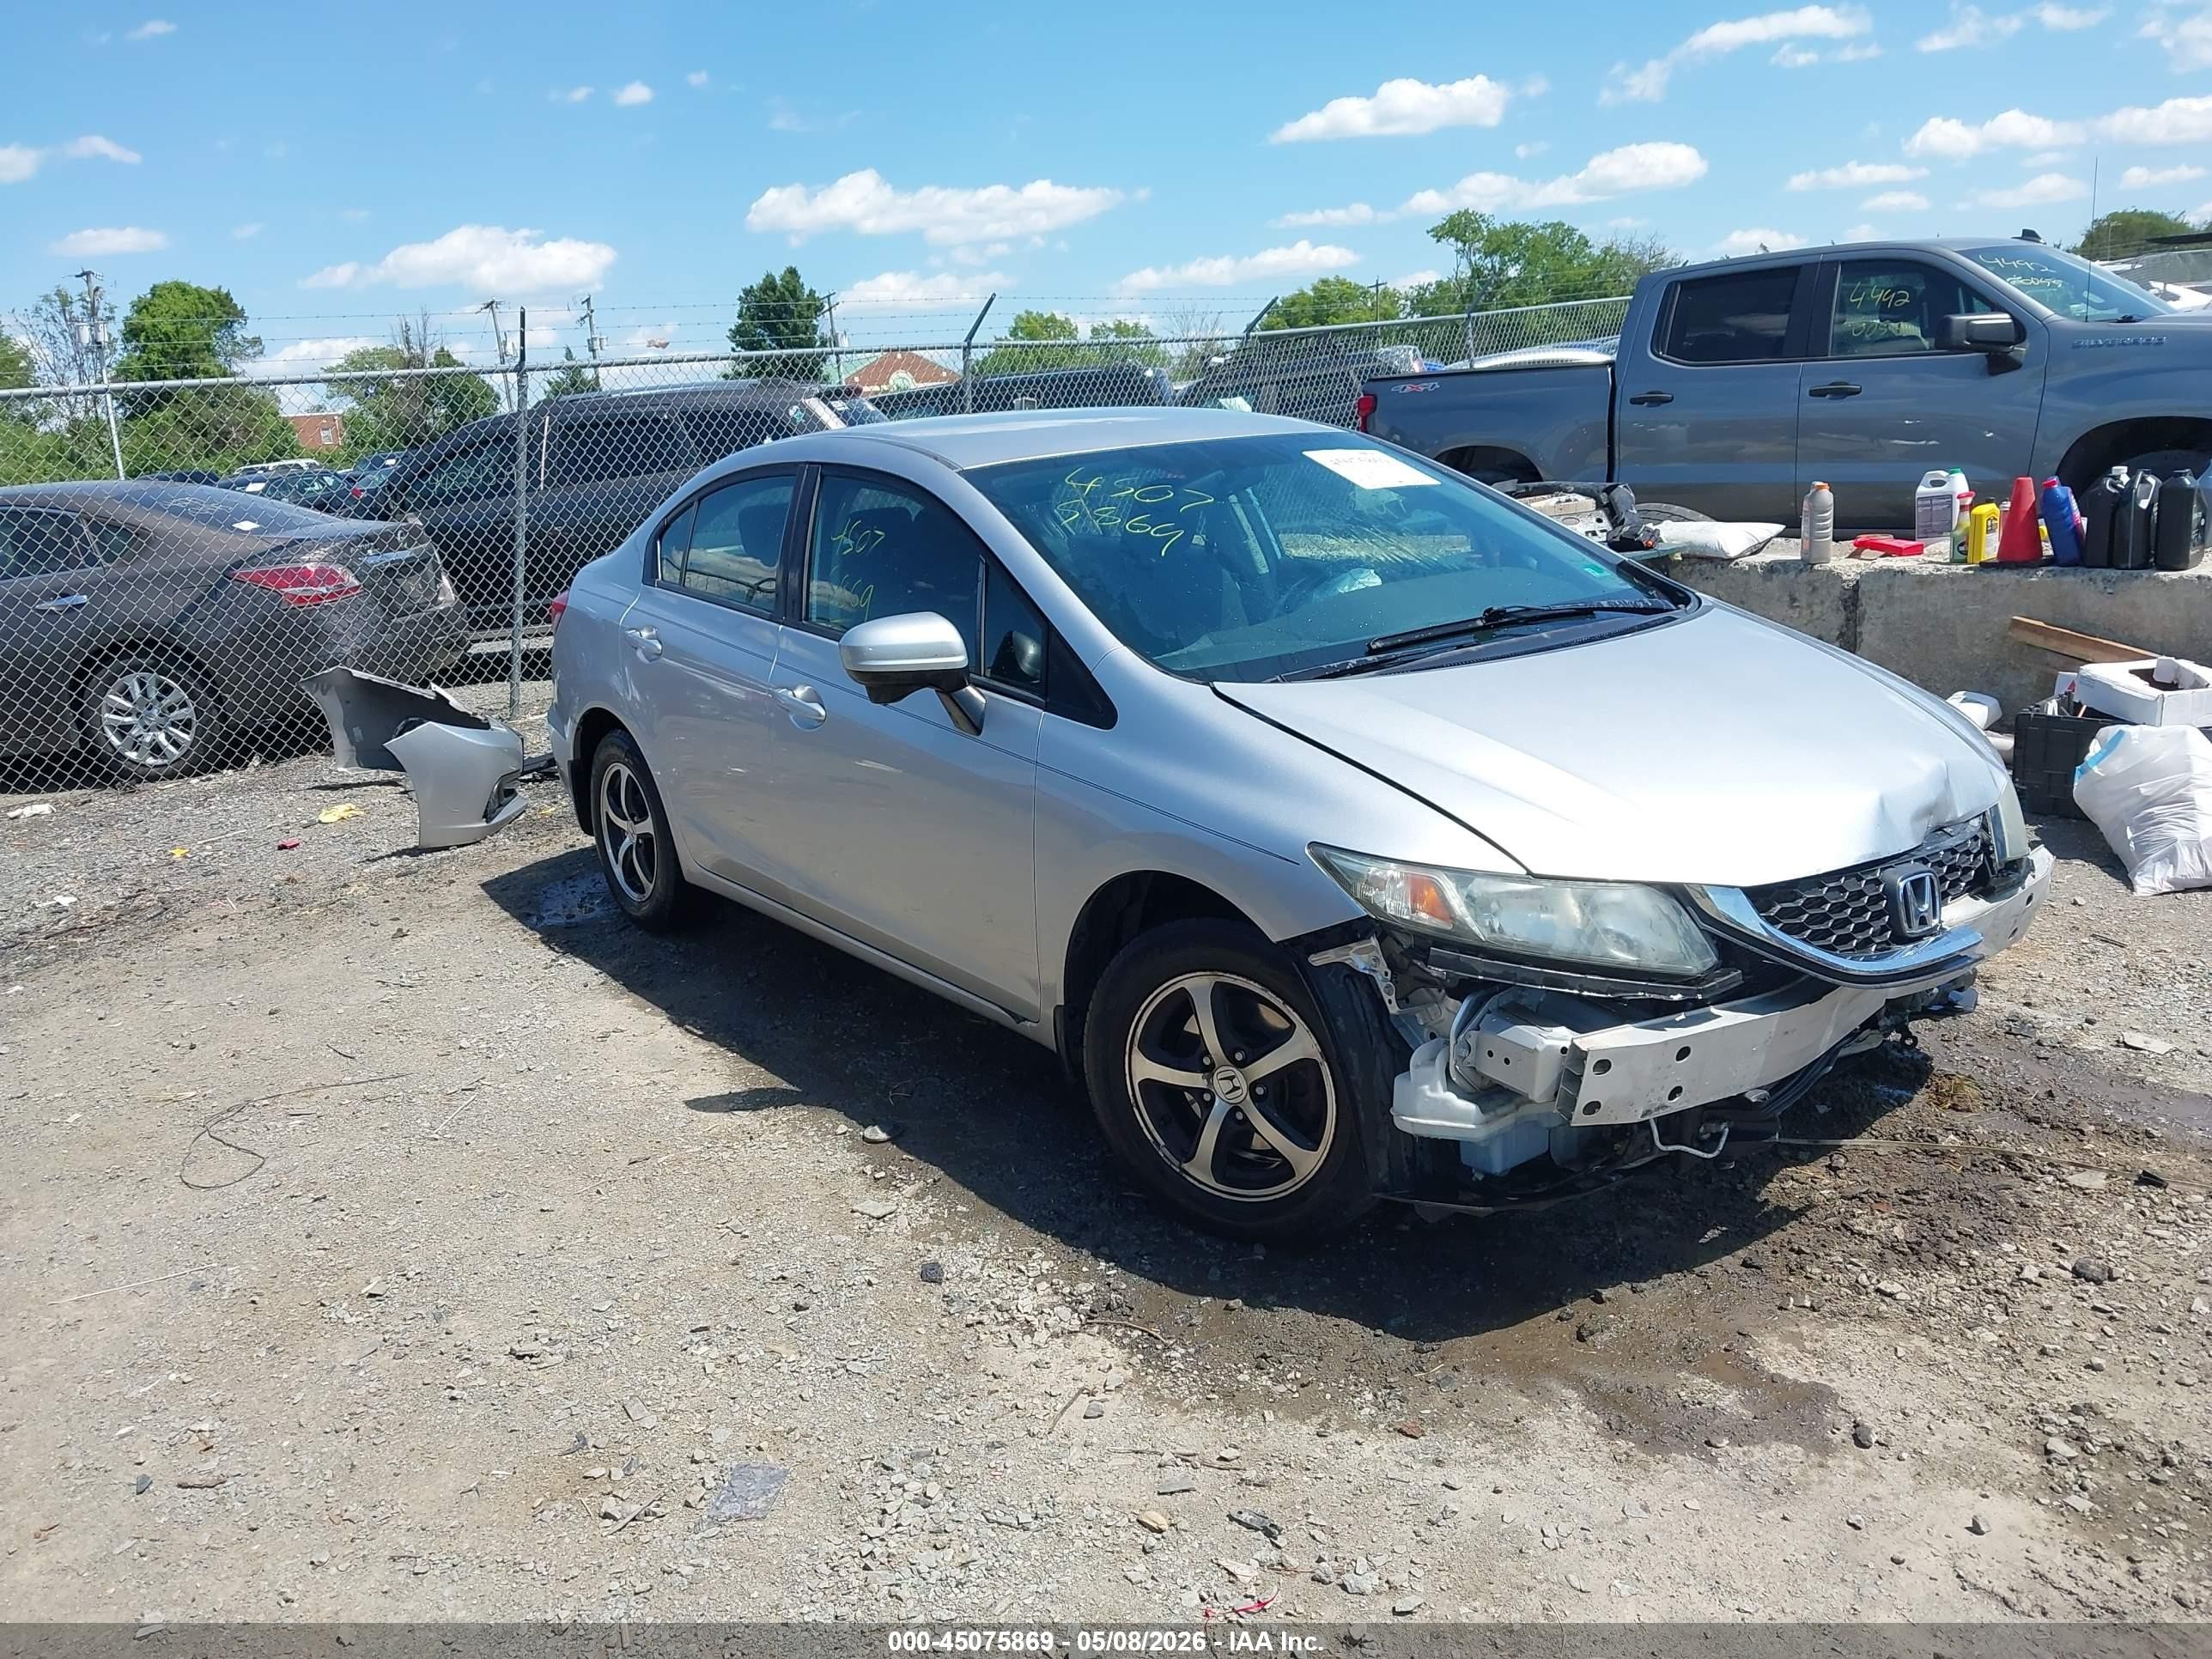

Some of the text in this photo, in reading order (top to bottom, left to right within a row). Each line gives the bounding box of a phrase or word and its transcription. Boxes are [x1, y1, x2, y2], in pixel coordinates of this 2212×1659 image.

[1850, 281, 1911, 309] 4492
[1064, 465, 1215, 514] 4507
[1056, 498, 1185, 557] 5869
